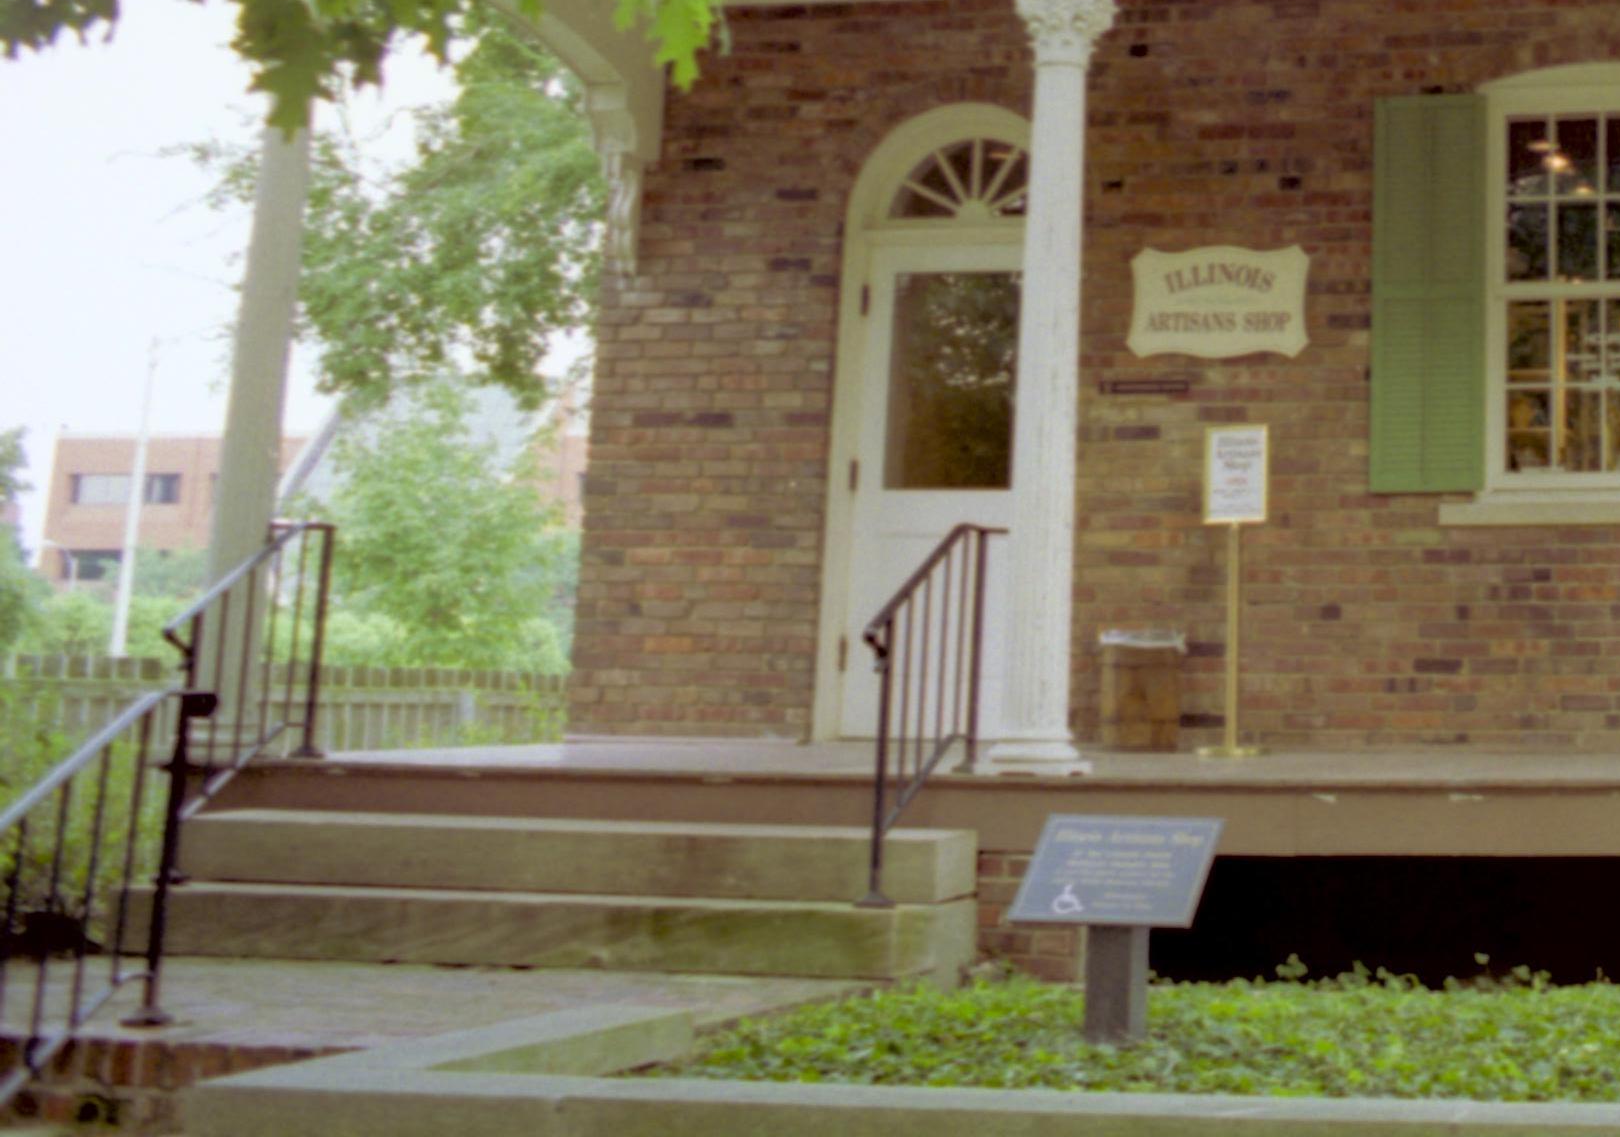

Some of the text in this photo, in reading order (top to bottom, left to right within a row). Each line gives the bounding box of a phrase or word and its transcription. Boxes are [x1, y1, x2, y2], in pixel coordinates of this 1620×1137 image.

[1164, 262, 1276, 295] ILLINOIS
[1146, 311, 1291, 333] ARTISANS SHOP
